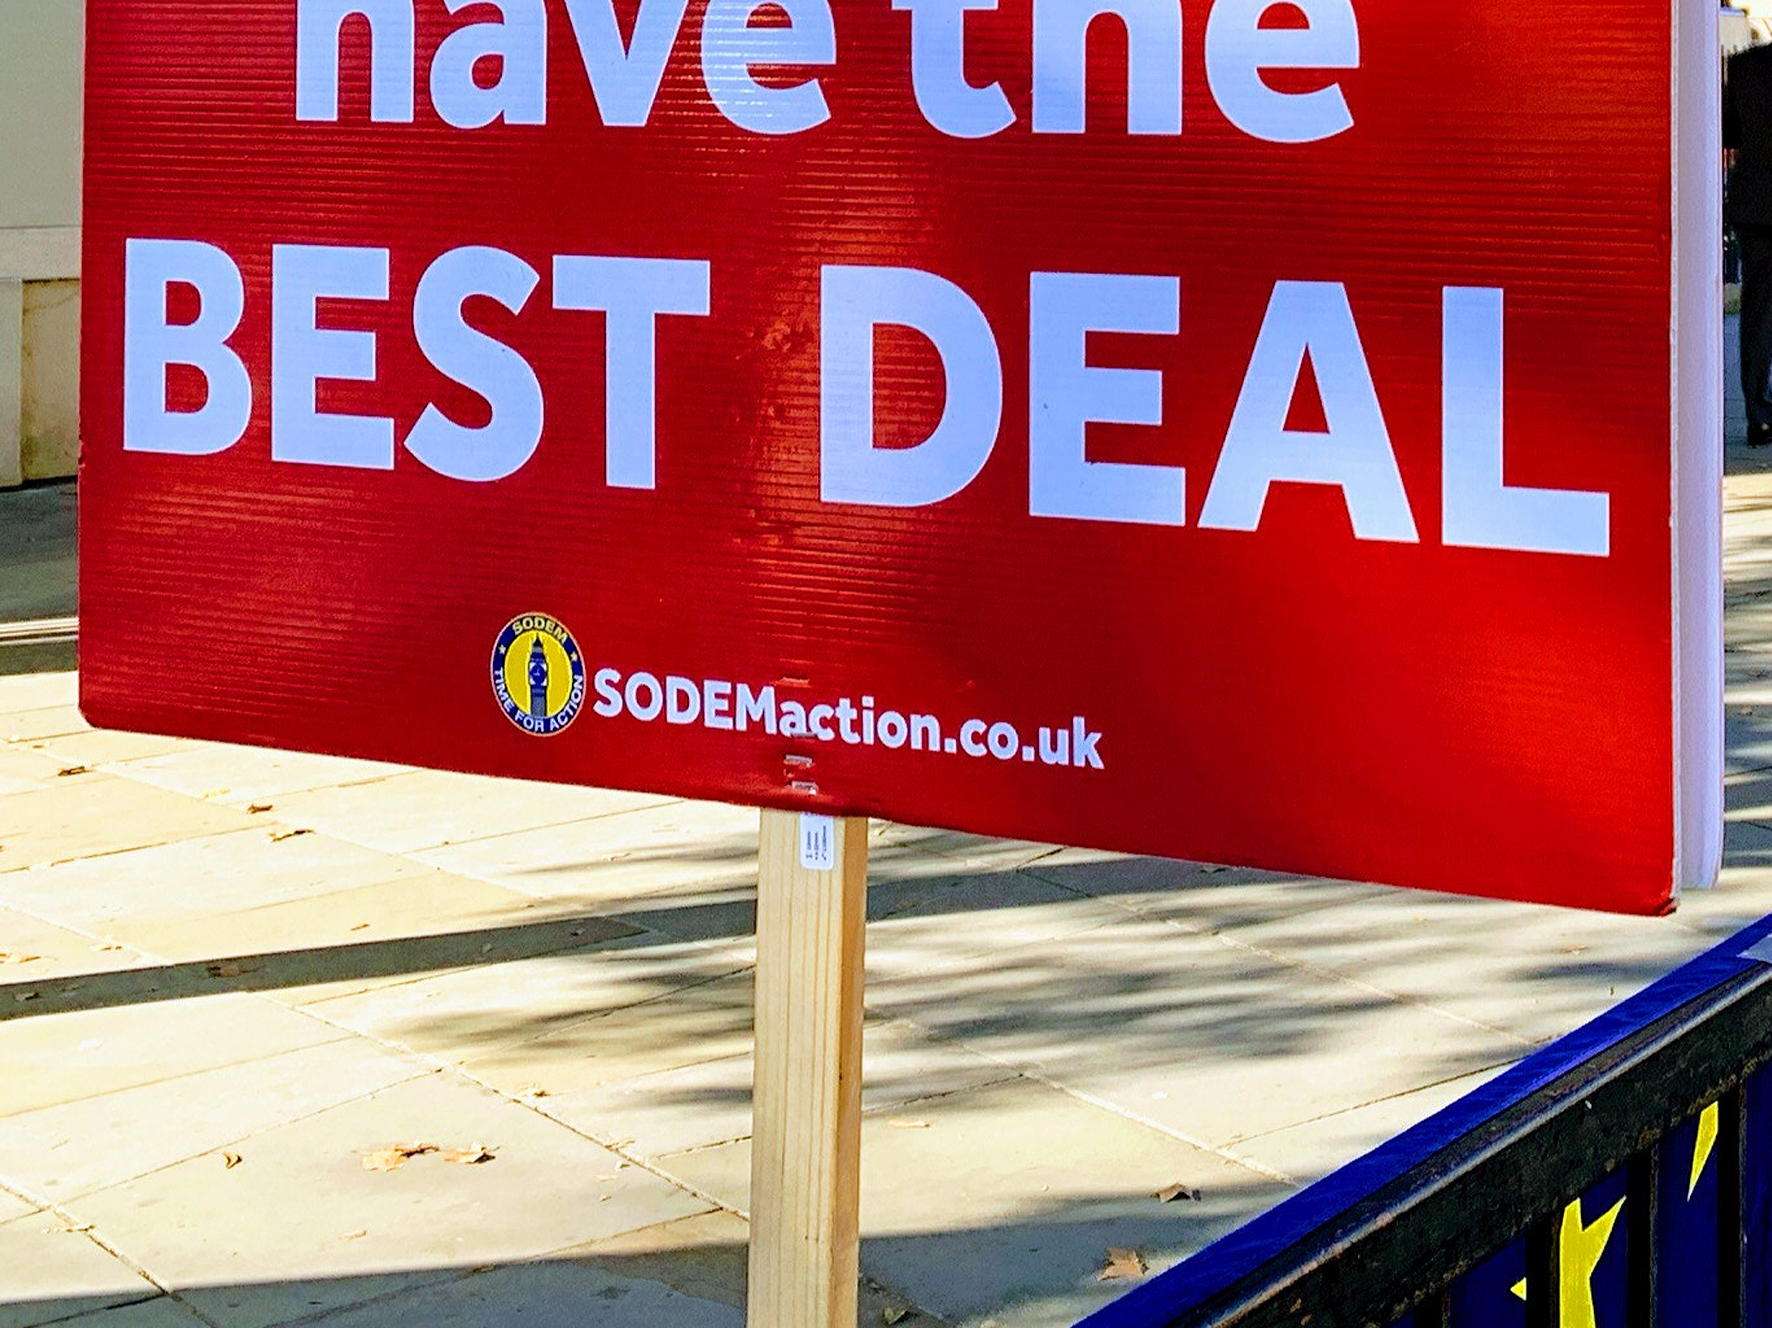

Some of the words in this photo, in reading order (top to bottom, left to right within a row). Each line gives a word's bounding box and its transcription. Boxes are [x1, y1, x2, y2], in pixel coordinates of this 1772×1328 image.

[123, 237, 711, 490] BEST
[819, 264, 1610, 557] DEAL
[512, 616, 569, 644] SODEM
[494, 666, 515, 713] TIME
[514, 709, 545, 732] FOR
[548, 674, 584, 732] ACTION
[593, 668, 1104, 769] SODEMaction.co.uk
